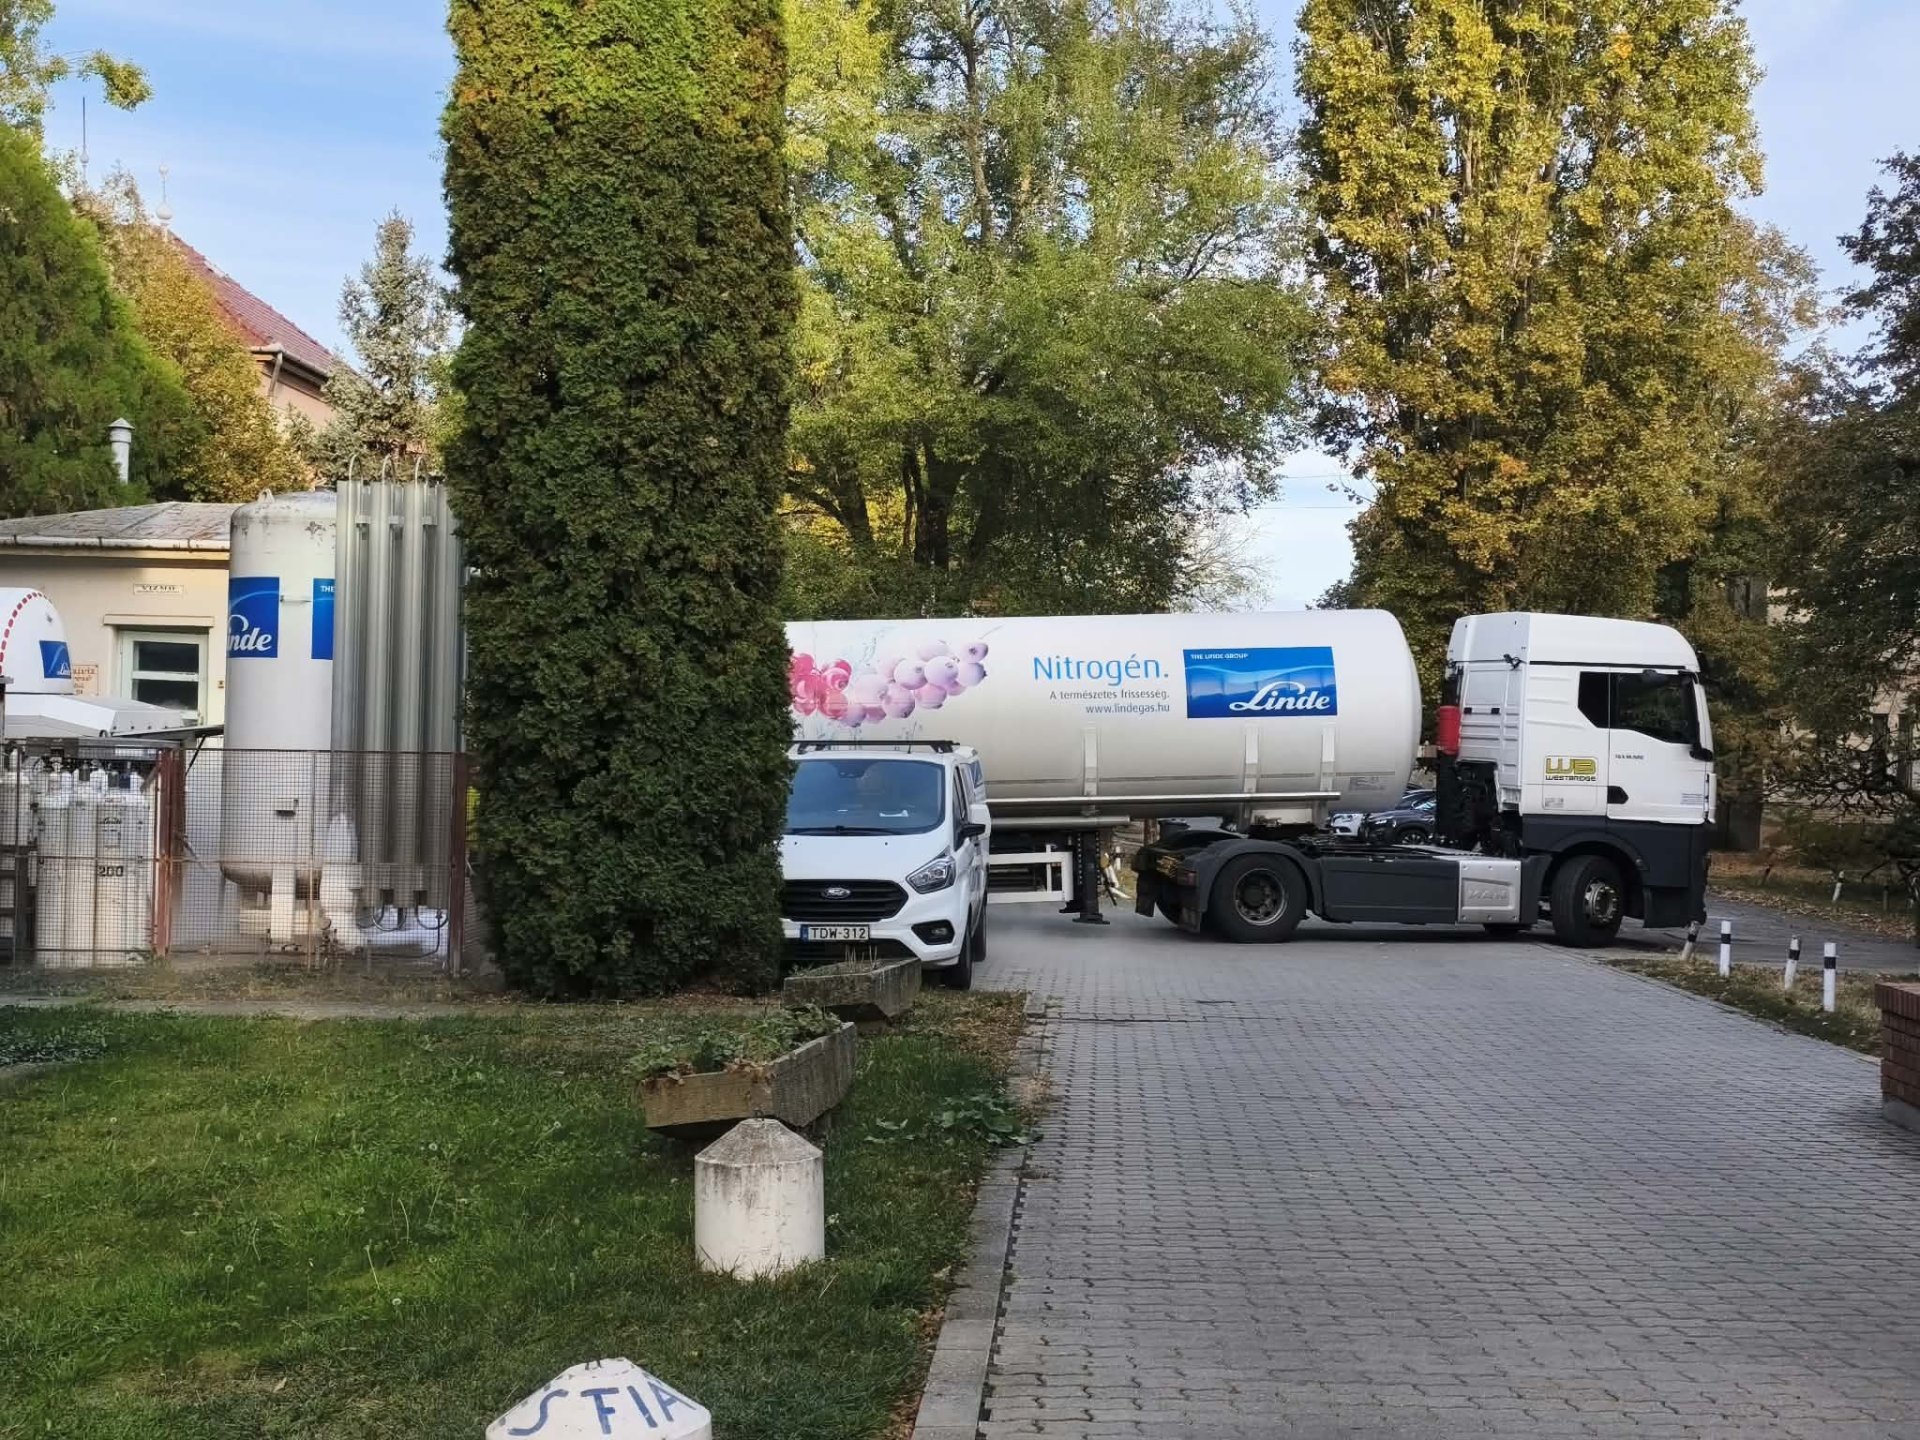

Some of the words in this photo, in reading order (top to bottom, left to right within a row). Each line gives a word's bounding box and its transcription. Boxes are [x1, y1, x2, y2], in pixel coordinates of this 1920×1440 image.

[320, 585, 335, 593] THE
[1033, 653, 1169, 686] Nitrogén.
[1049, 690, 1057, 700] A
[1060, 689, 1118, 700] természetes
[1121, 688, 1170, 701] frissesség.
[1229, 680, 1331, 711] Linde
[1085, 702, 1170, 714] www.lindegas.hu
[99, 865, 124, 877] 200
[810, 927, 867, 939] TDW-312
